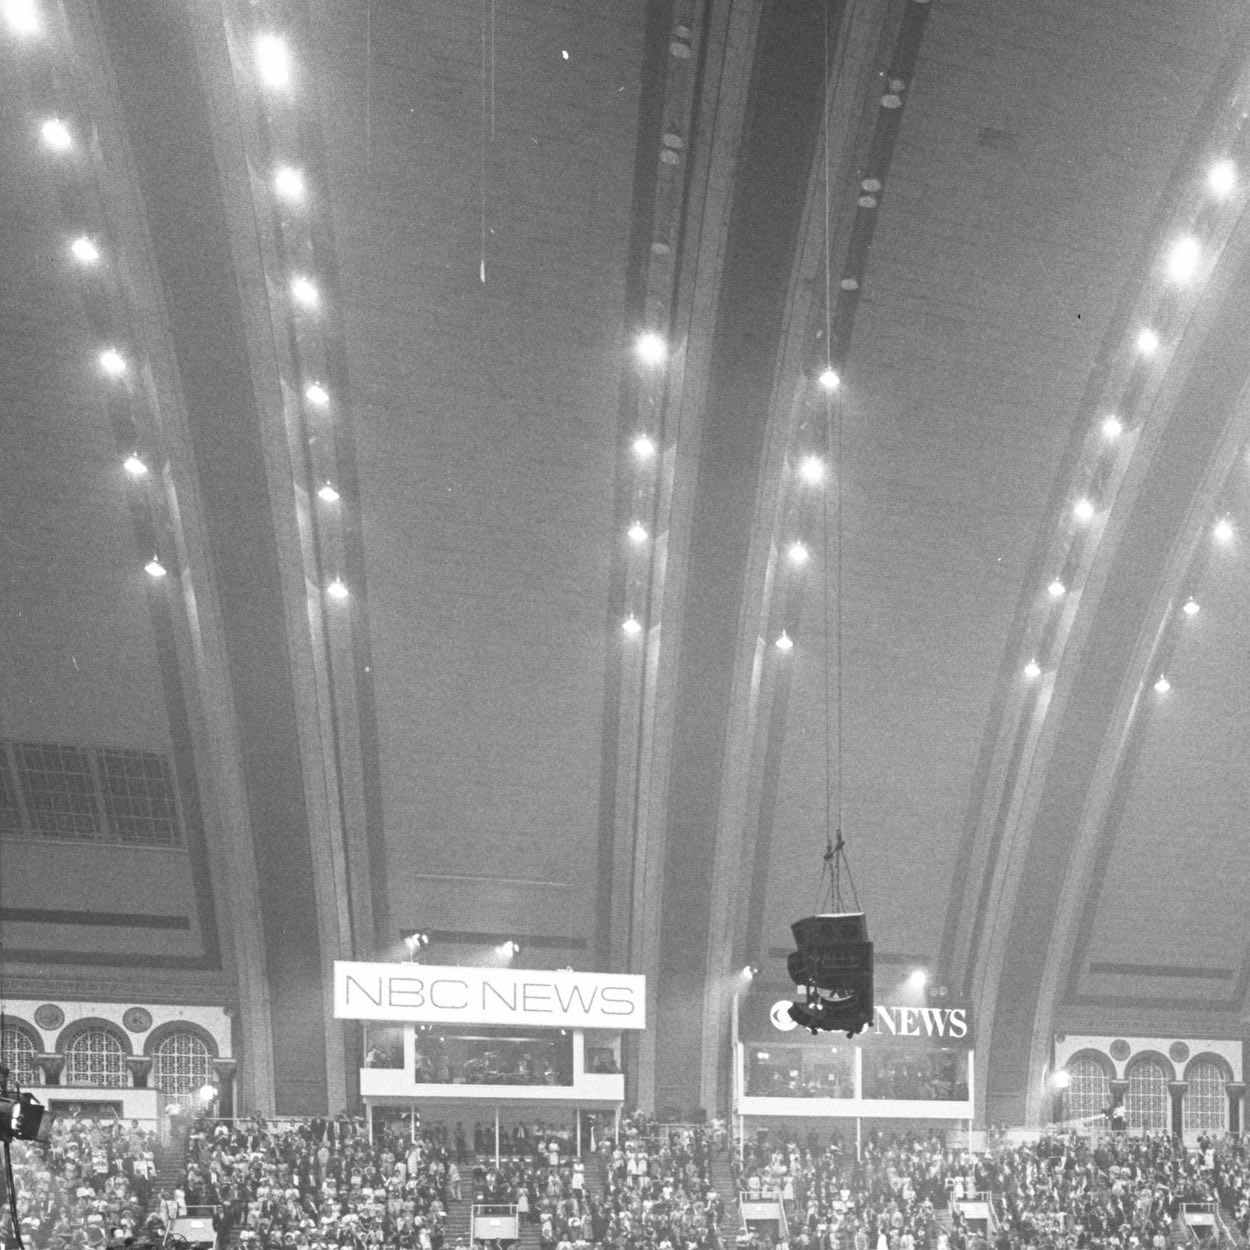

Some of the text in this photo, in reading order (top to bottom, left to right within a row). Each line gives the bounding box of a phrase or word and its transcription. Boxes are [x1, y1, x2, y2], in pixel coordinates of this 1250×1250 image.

[346, 975, 635, 1016] NBC NEWS
[873, 1004, 968, 1038] NEWS
